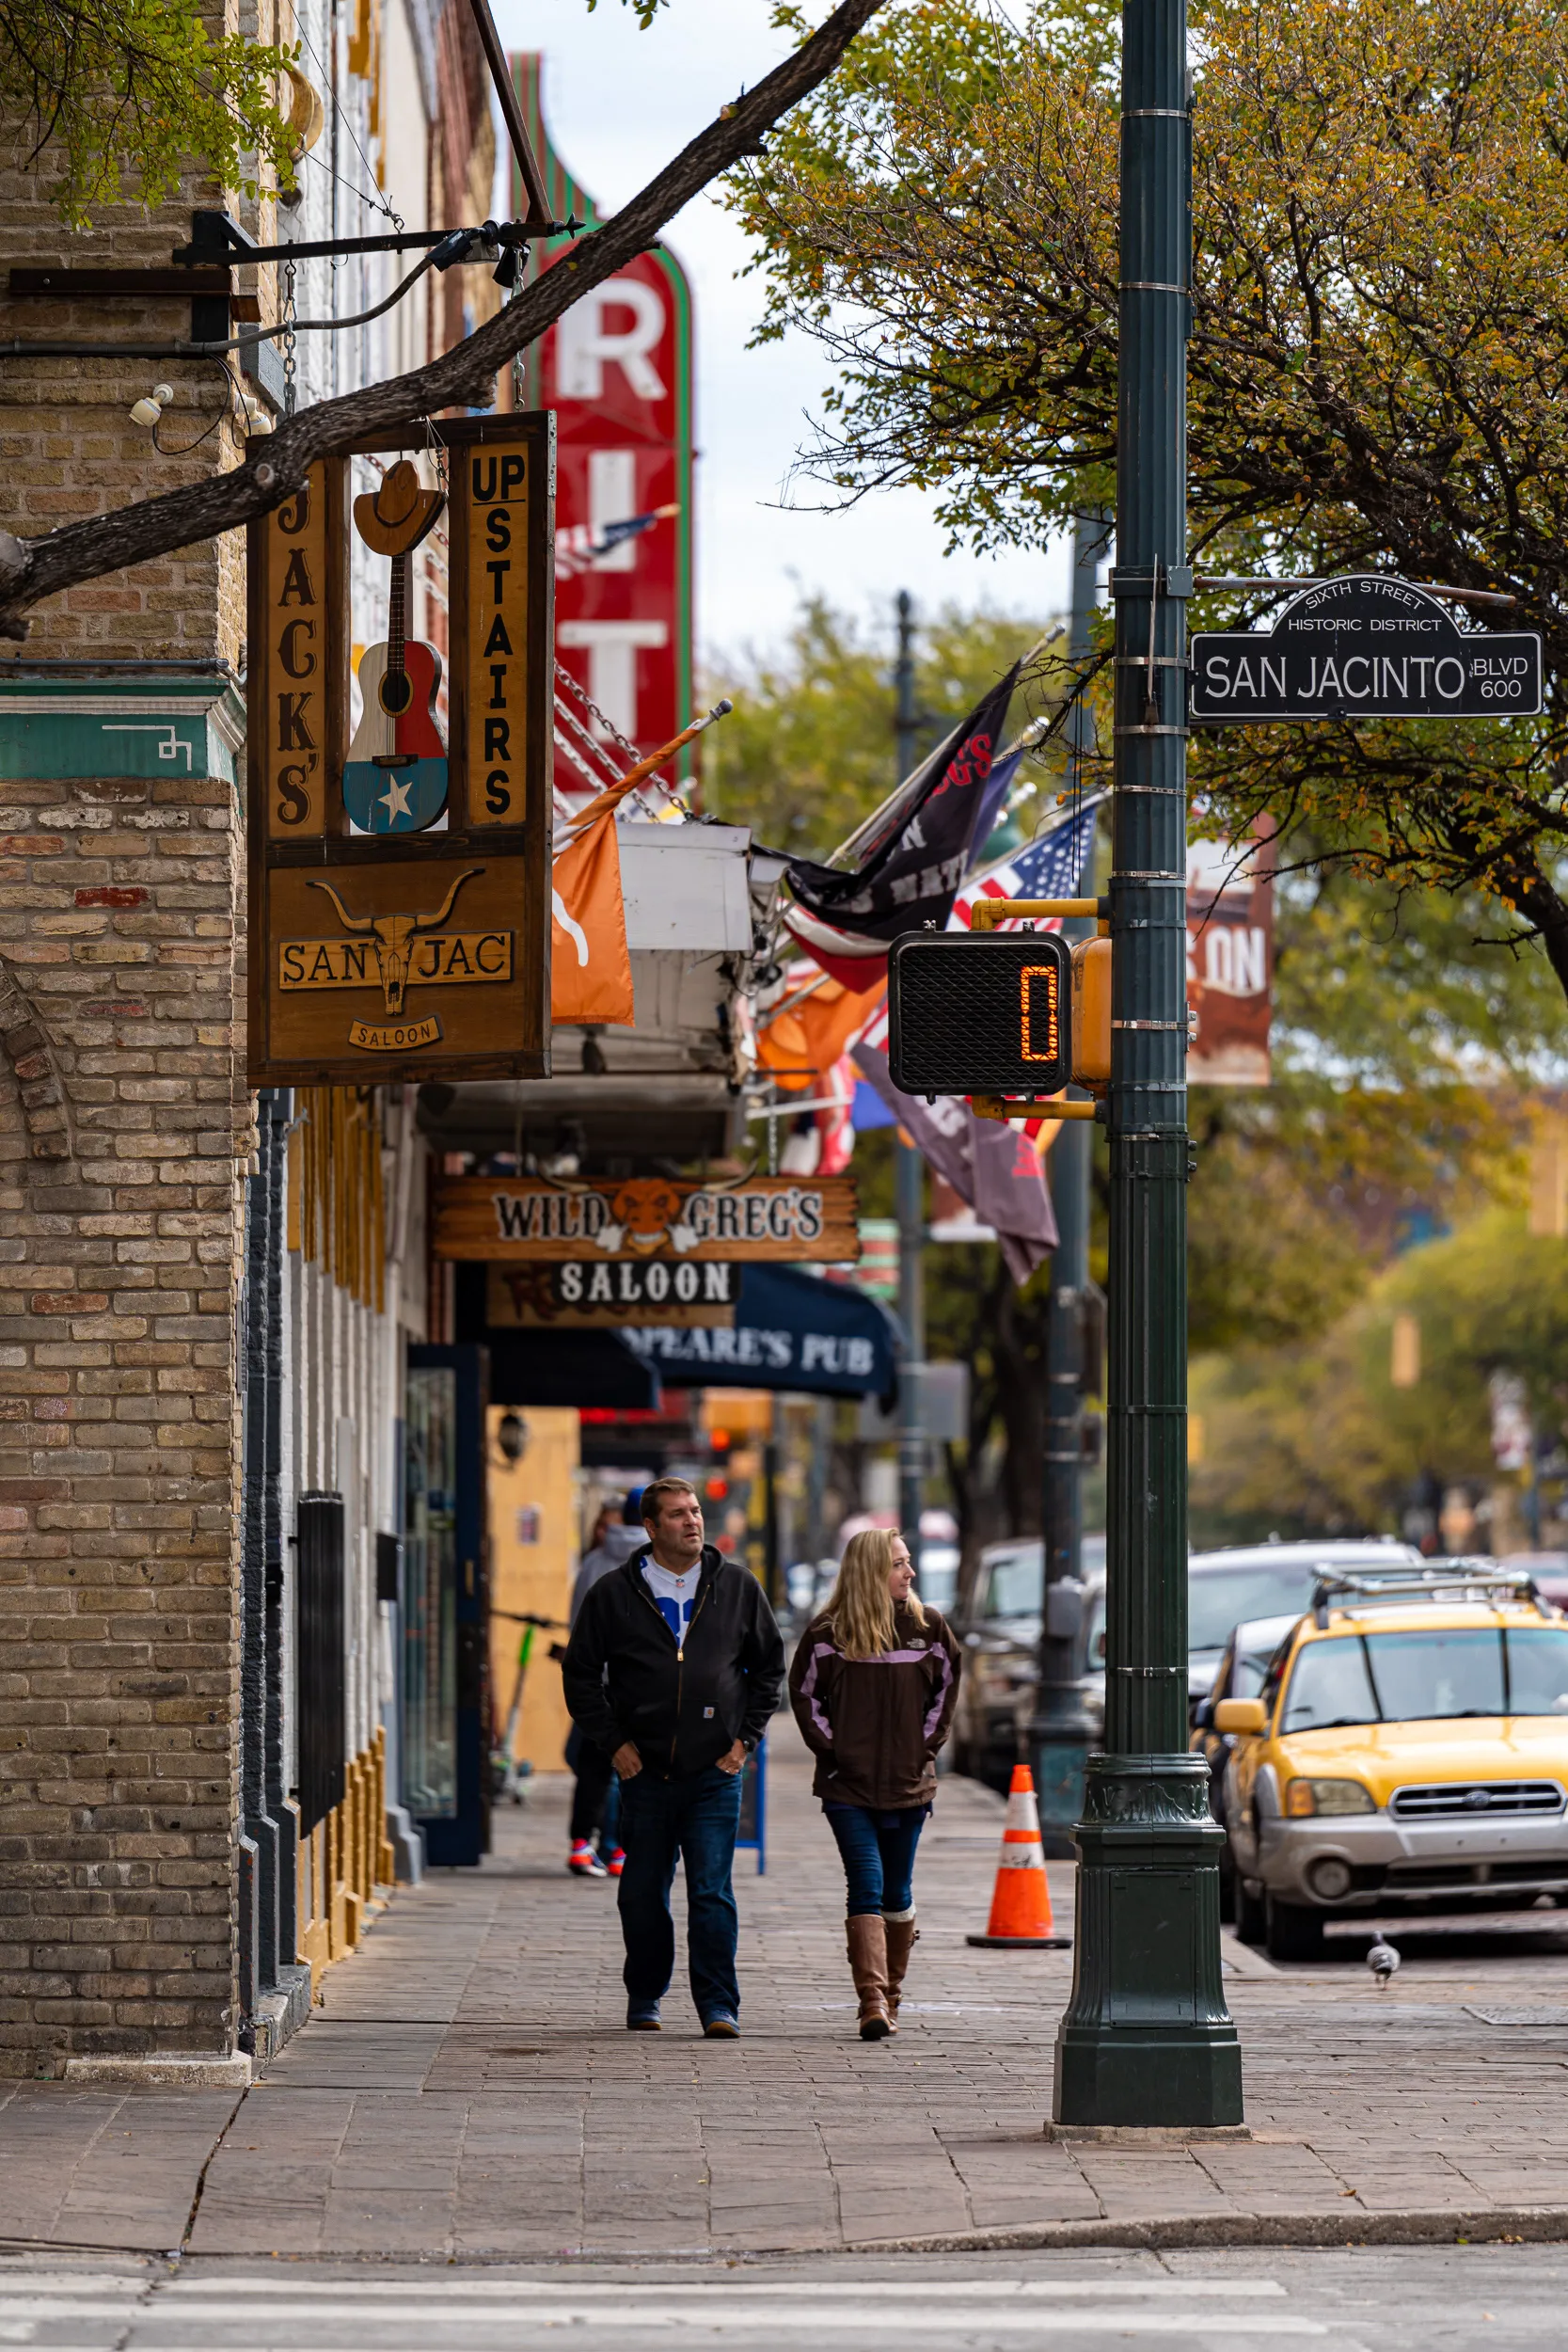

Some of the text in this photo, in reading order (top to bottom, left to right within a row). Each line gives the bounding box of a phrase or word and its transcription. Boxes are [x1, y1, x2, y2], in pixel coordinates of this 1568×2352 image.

[1305, 580, 1426, 611] SIXTH STREET
[1288, 618, 1443, 632] HISTORIC DISTRICT
[1205, 656, 1465, 699] SAN JACINTO
[1472, 658, 1528, 675] BLVD
[1480, 680, 1523, 699] 600
[283, 935, 506, 983] SAN JAC
[357, 1024, 433, 1048] SALOON
[492, 1186, 823, 1242] WILD GREG'S
[561, 1262, 733, 1302] SALOON
[800, 1333, 875, 1376] PUB
